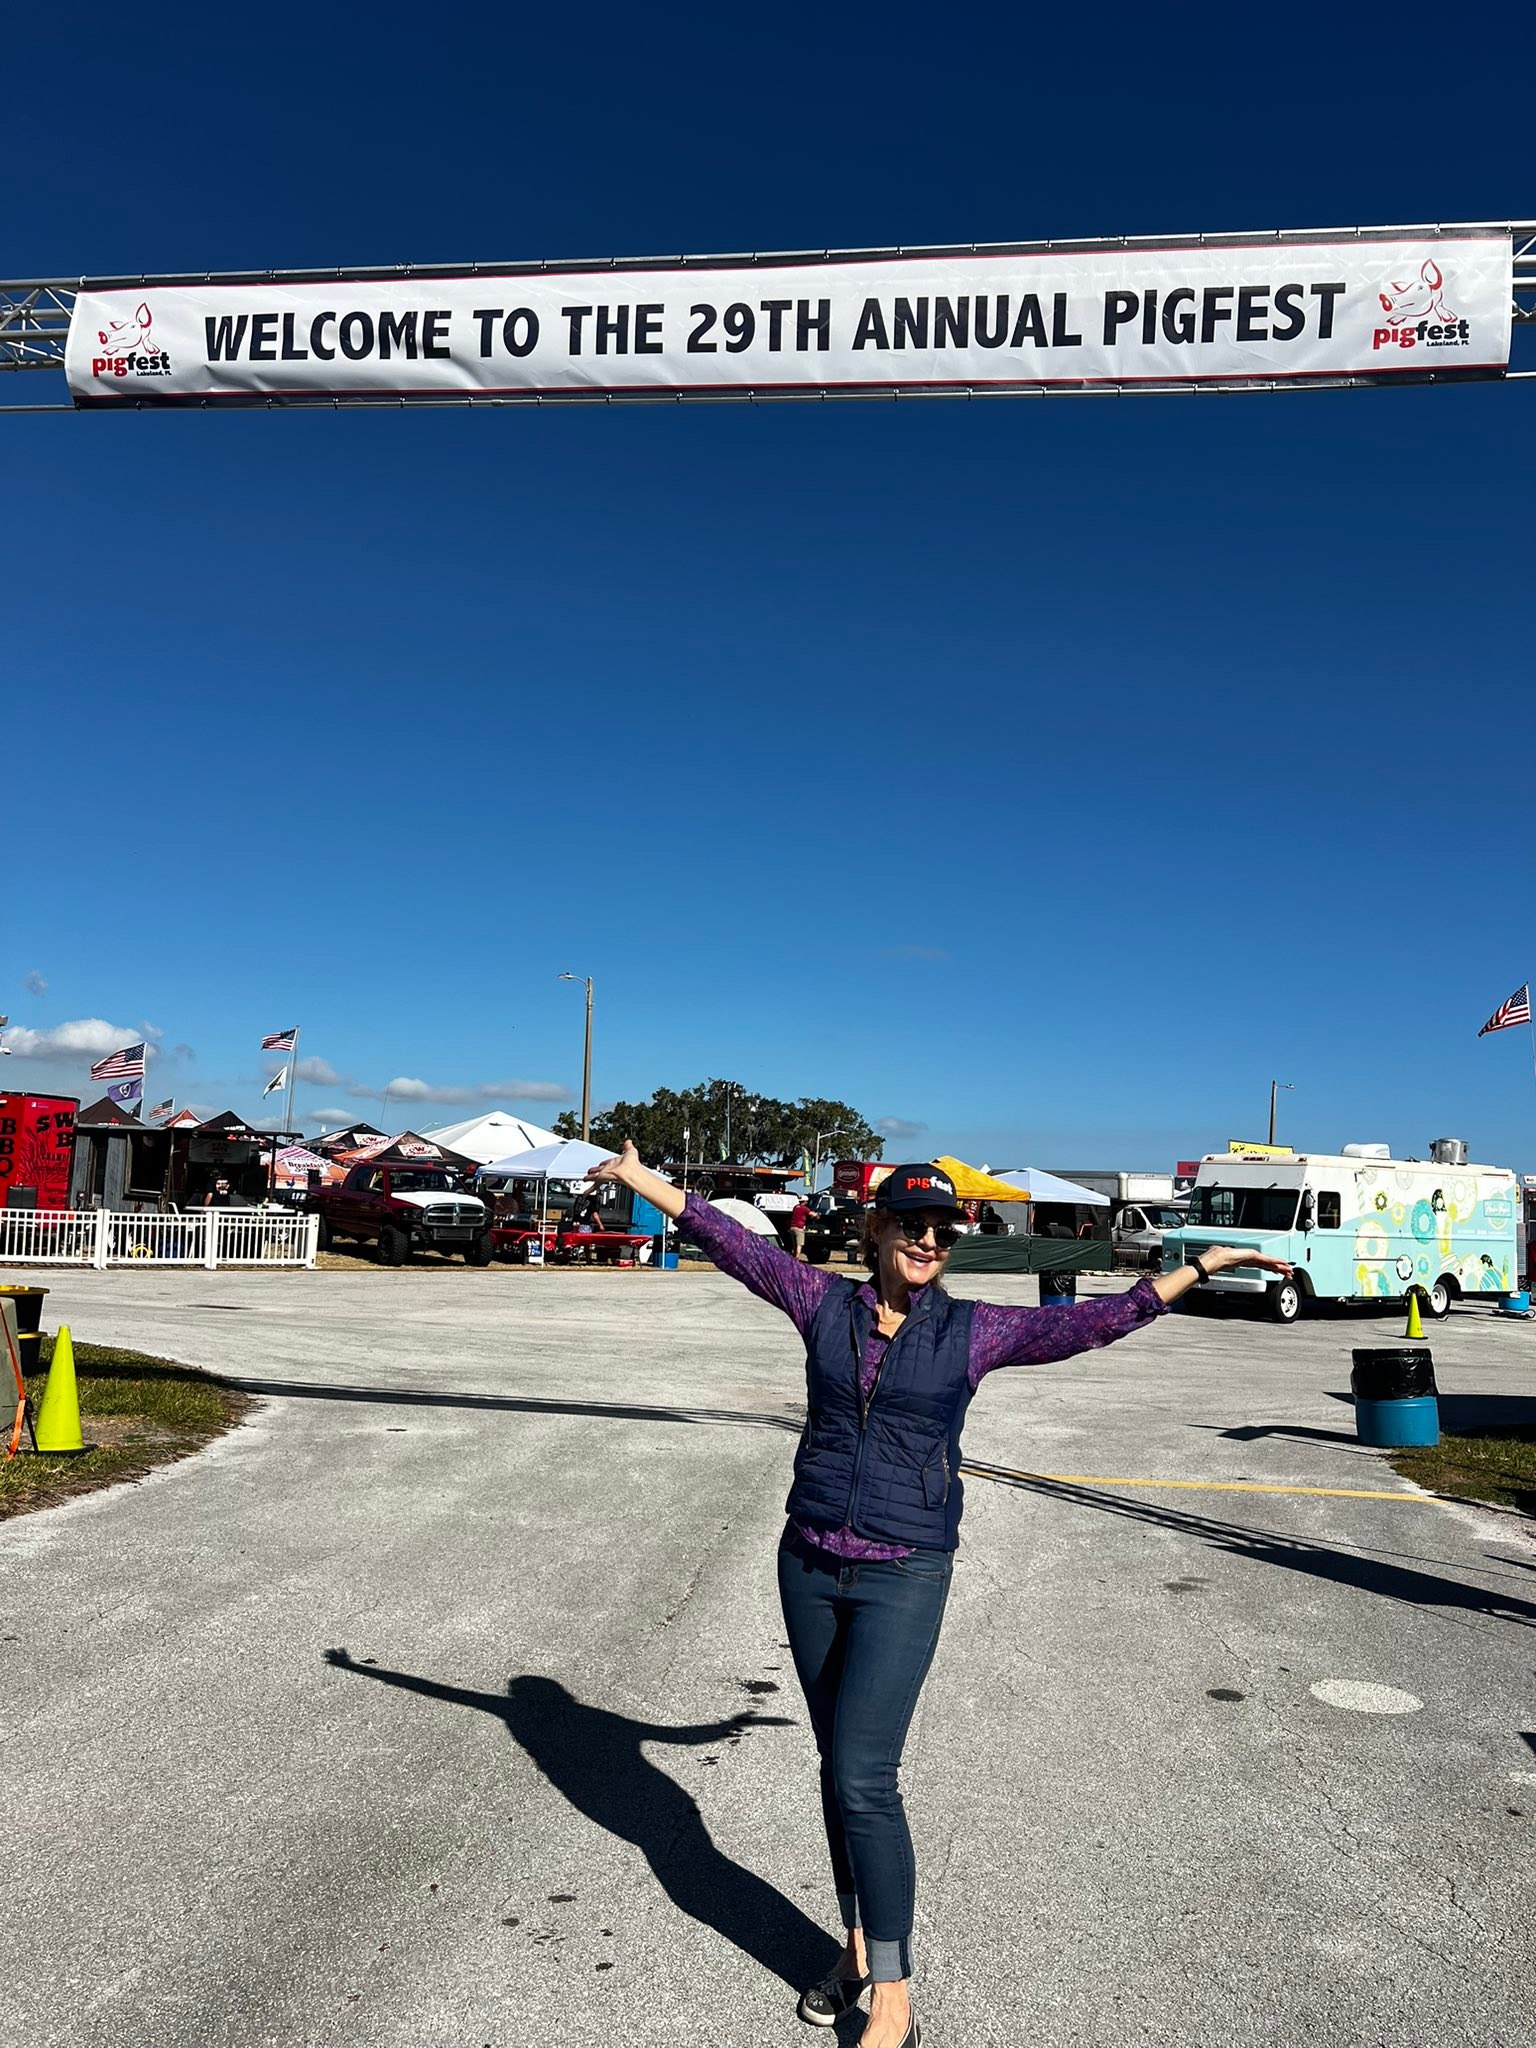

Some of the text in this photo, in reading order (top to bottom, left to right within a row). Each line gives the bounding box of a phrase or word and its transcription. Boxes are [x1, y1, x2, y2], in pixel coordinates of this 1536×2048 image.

[205, 282, 1346, 362] WELCOME TO THE 29TH ANNUAL PIGFEST
[1373, 319, 1470, 350] pigfest
[92, 352, 171, 378] pigfest
[906, 1176, 954, 1195] pigfest
